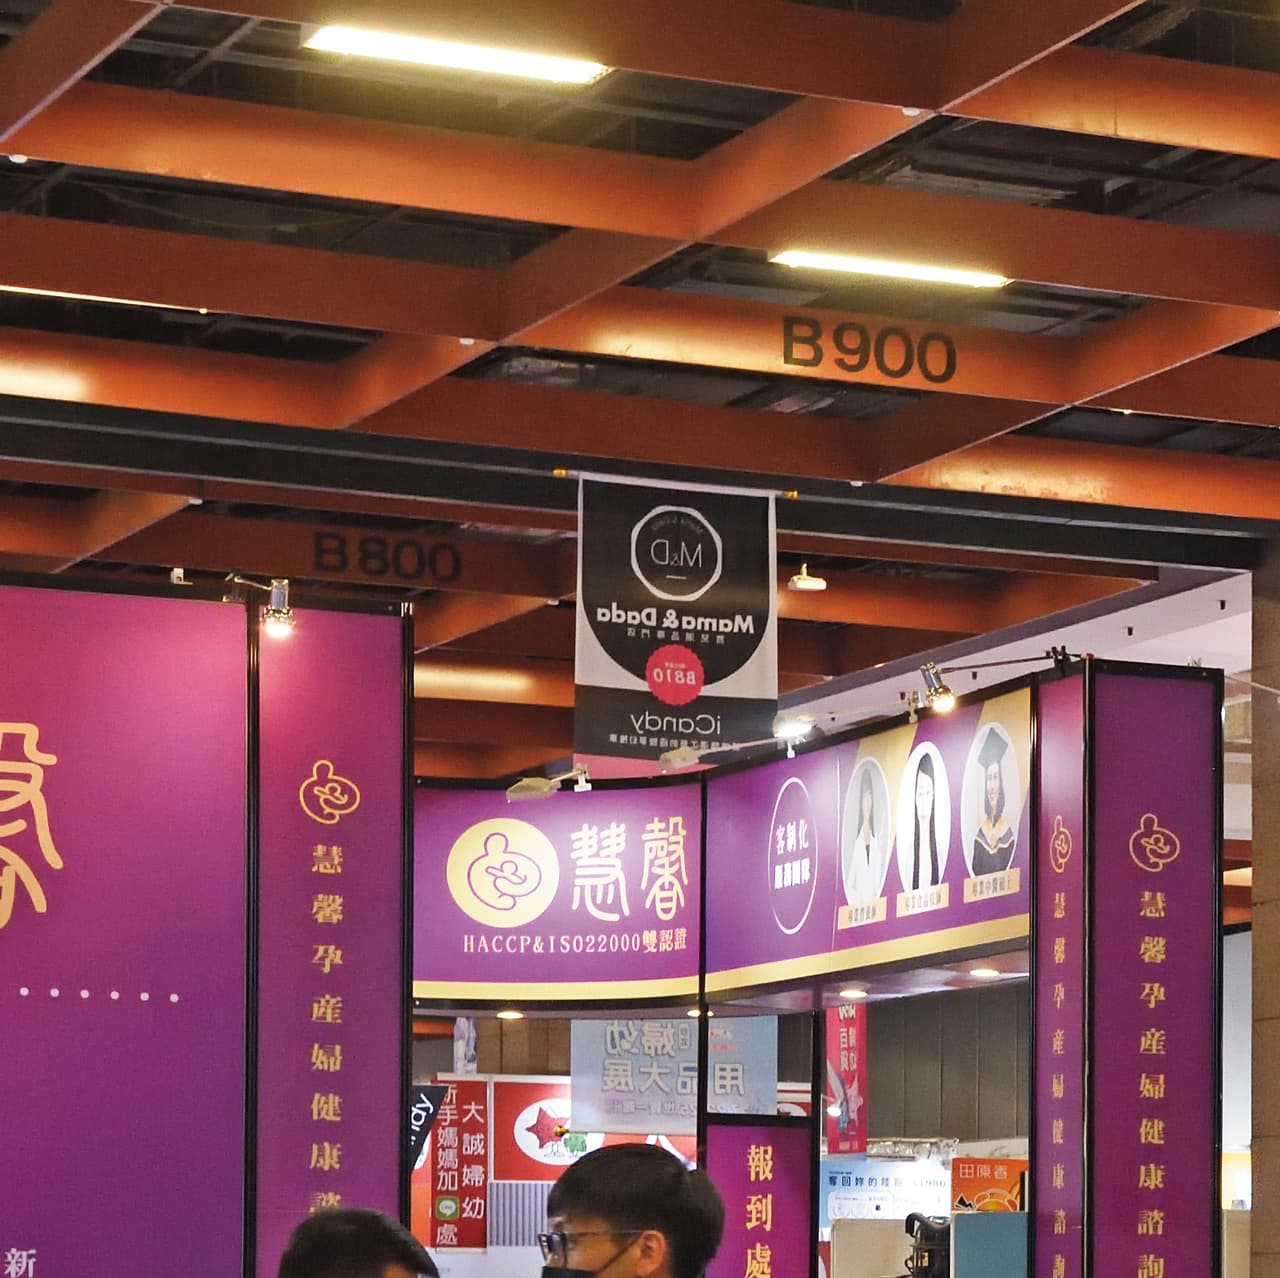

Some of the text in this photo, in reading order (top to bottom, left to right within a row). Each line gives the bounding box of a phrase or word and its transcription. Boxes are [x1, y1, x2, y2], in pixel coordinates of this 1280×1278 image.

[783, 315, 957, 383] B900
[314, 531, 463, 585] B800
[570, 816, 688, 922] 慧馨
[462, 1101, 485, 1219] 大誠婦幼
